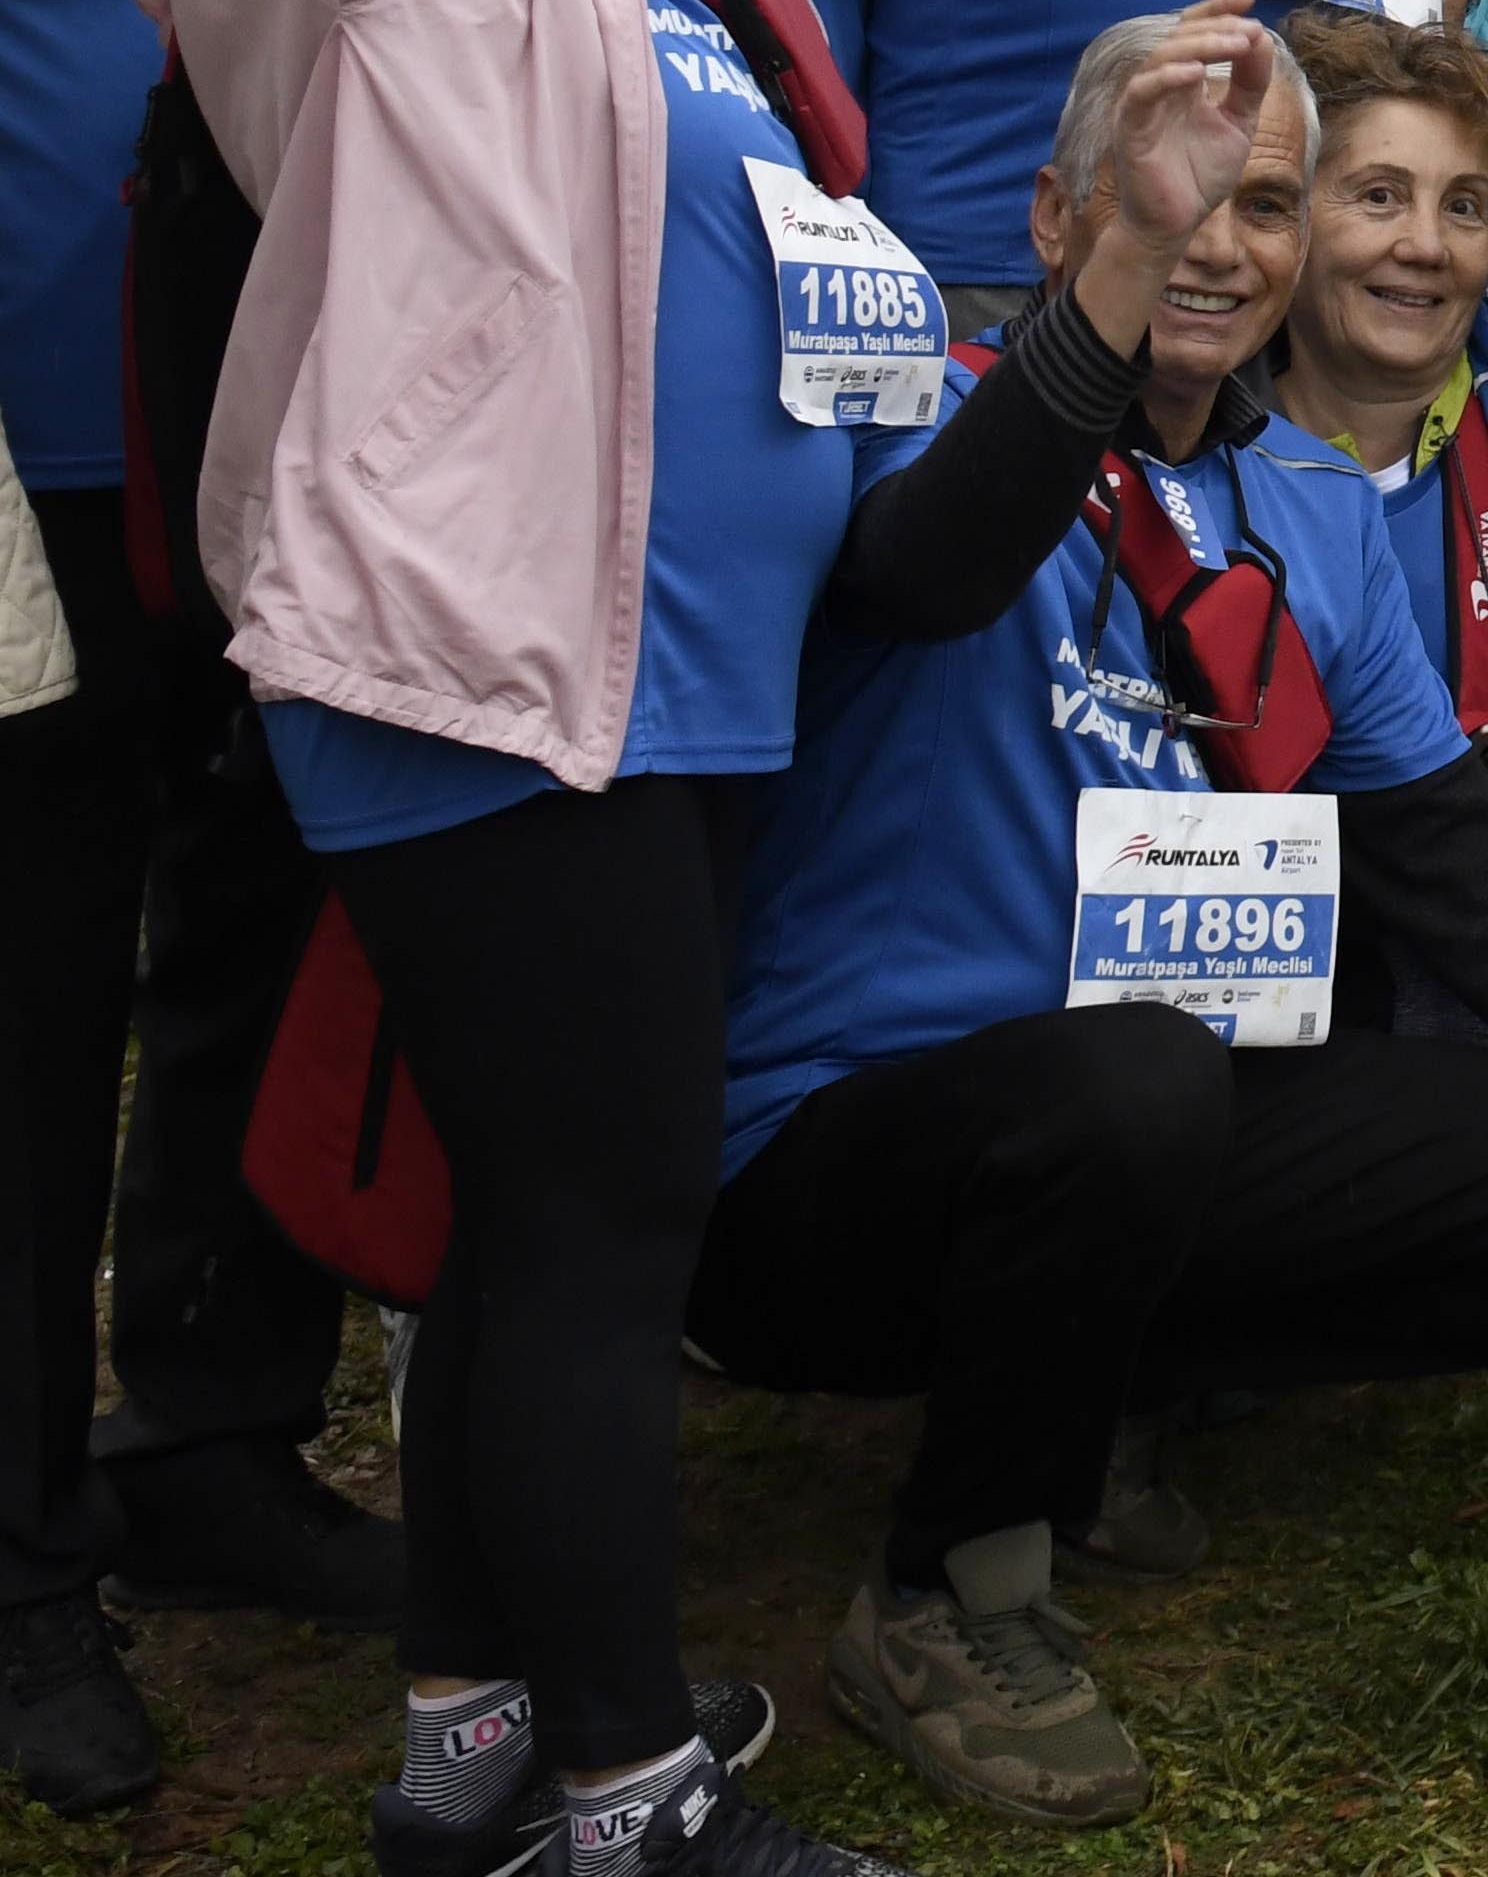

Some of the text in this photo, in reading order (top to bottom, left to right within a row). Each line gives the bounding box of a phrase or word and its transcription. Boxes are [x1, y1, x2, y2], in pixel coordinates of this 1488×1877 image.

[800, 267, 927, 329] 11885
[789, 330, 935, 356] Muratpaşa Yaşlı Meclisi
[1145, 849, 1240, 866] RUNTALYA
[1281, 855, 1318, 865] ANTALYA
[1115, 898, 1305, 953] 11896
[1095, 956, 1313, 981] Muratpaşa Yaşlı Meclisi
[451, 1700, 528, 1756] LOV
[680, 1785, 708, 1824] NIKE
[573, 1807, 642, 1845] LOVE
